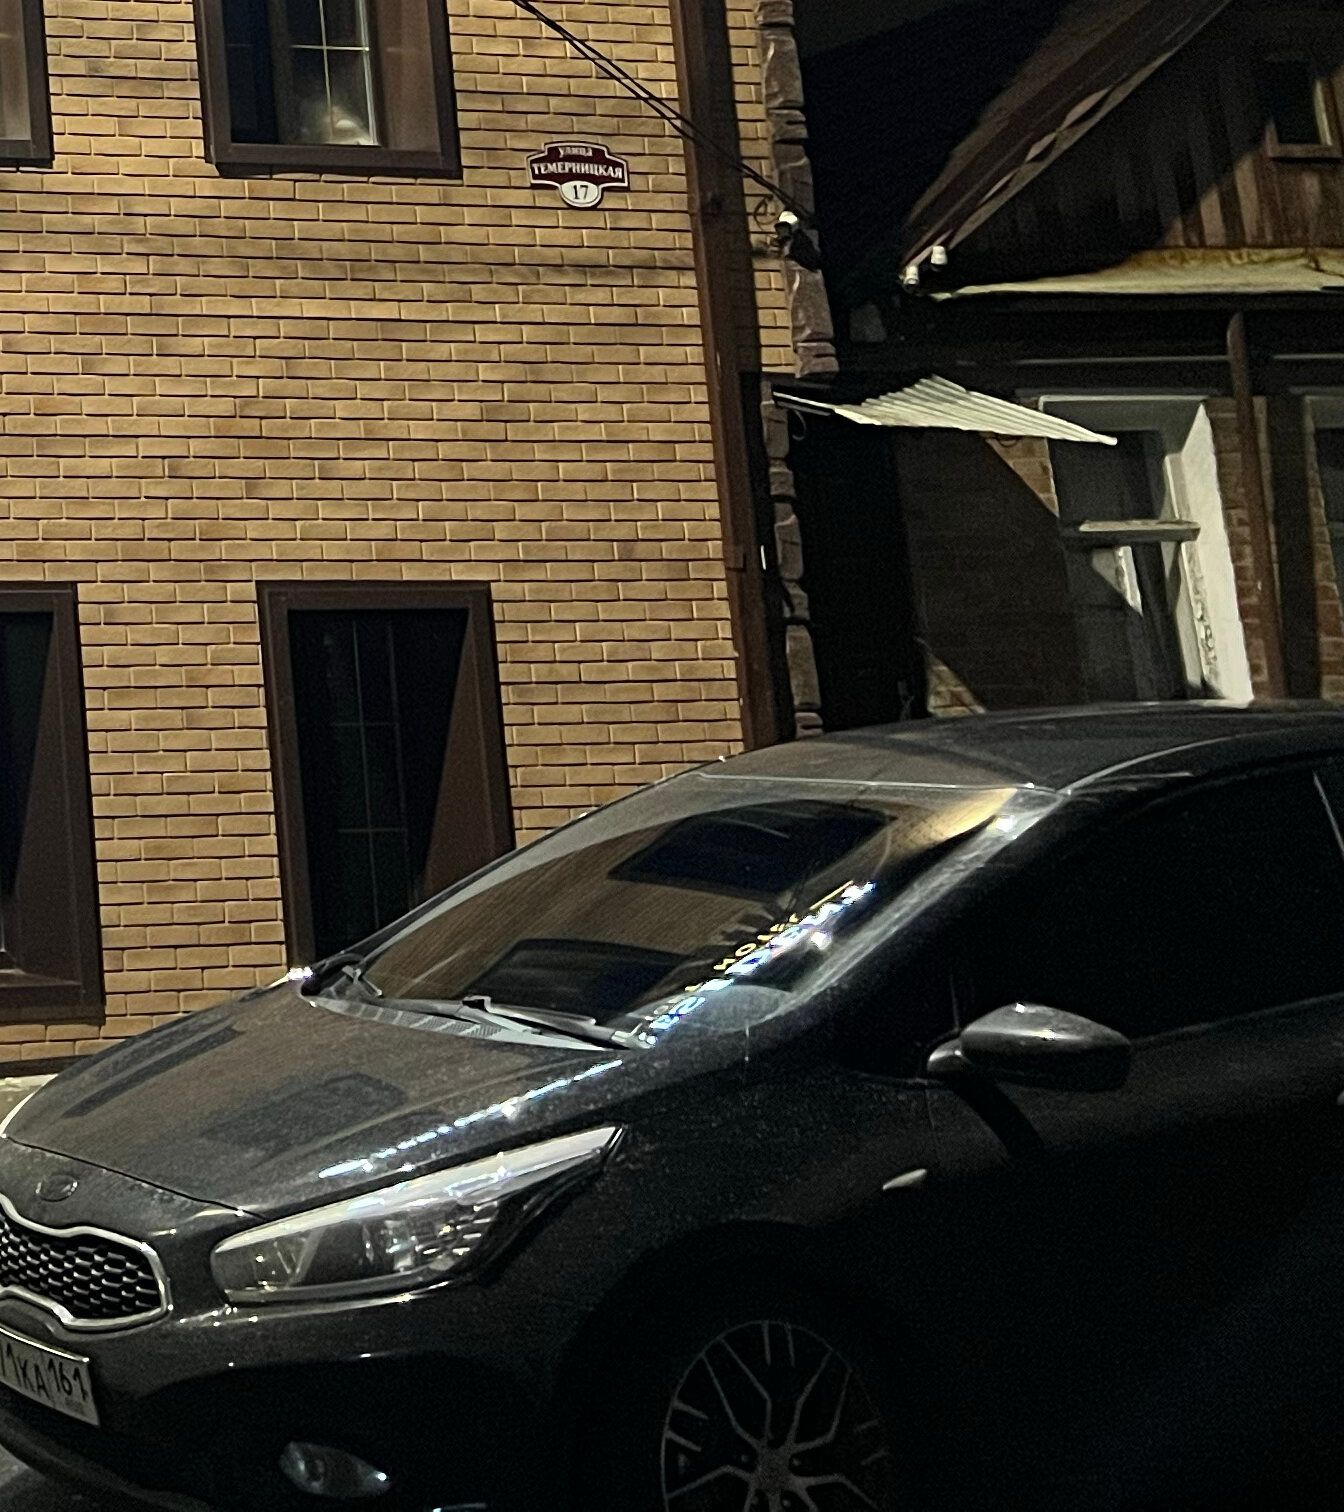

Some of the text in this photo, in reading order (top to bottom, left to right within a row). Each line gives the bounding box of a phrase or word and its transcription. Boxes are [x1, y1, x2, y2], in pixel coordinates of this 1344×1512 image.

[532, 162, 623, 179] ТЕМЕРНИЦКАЯ
[573, 185, 589, 200] 17
[48, 1358, 88, 1402] 161
